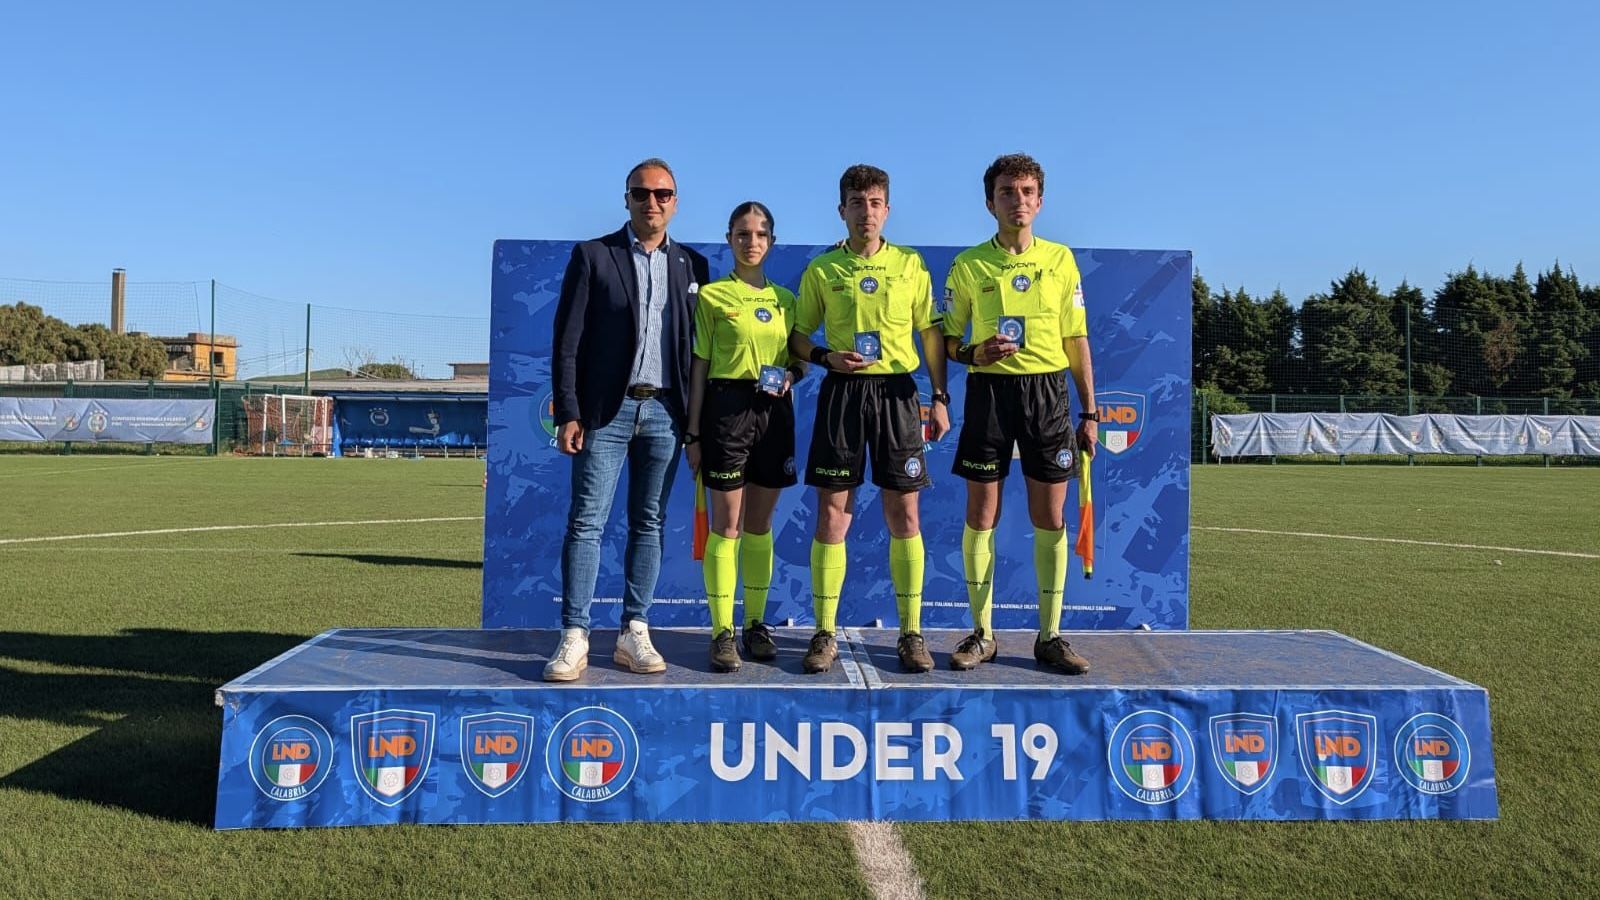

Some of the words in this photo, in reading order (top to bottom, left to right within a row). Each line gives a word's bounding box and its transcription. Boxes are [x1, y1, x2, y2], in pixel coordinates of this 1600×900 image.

[1098, 405, 1137, 424] LND
[815, 467, 850, 477] GIVOVA
[962, 459, 996, 471] GIVOVA
[271, 742, 311, 762] LND
[367, 735, 417, 760] LND
[474, 735, 519, 756] LND
[571, 737, 614, 759] LND
[709, 722, 966, 783] UNDER
[990, 722, 1060, 782] 19
[1131, 741, 1172, 762] LND
[1225, 734, 1265, 755] LND
[1314, 735, 1361, 758] LND
[1414, 738, 1450, 757] LND
[270, 785, 308, 799] CALABRIA
[571, 785, 612, 800] CALABRIA
[1135, 787, 1176, 801] CALABRIA
[1418, 780, 1454, 792] CALABRIA
